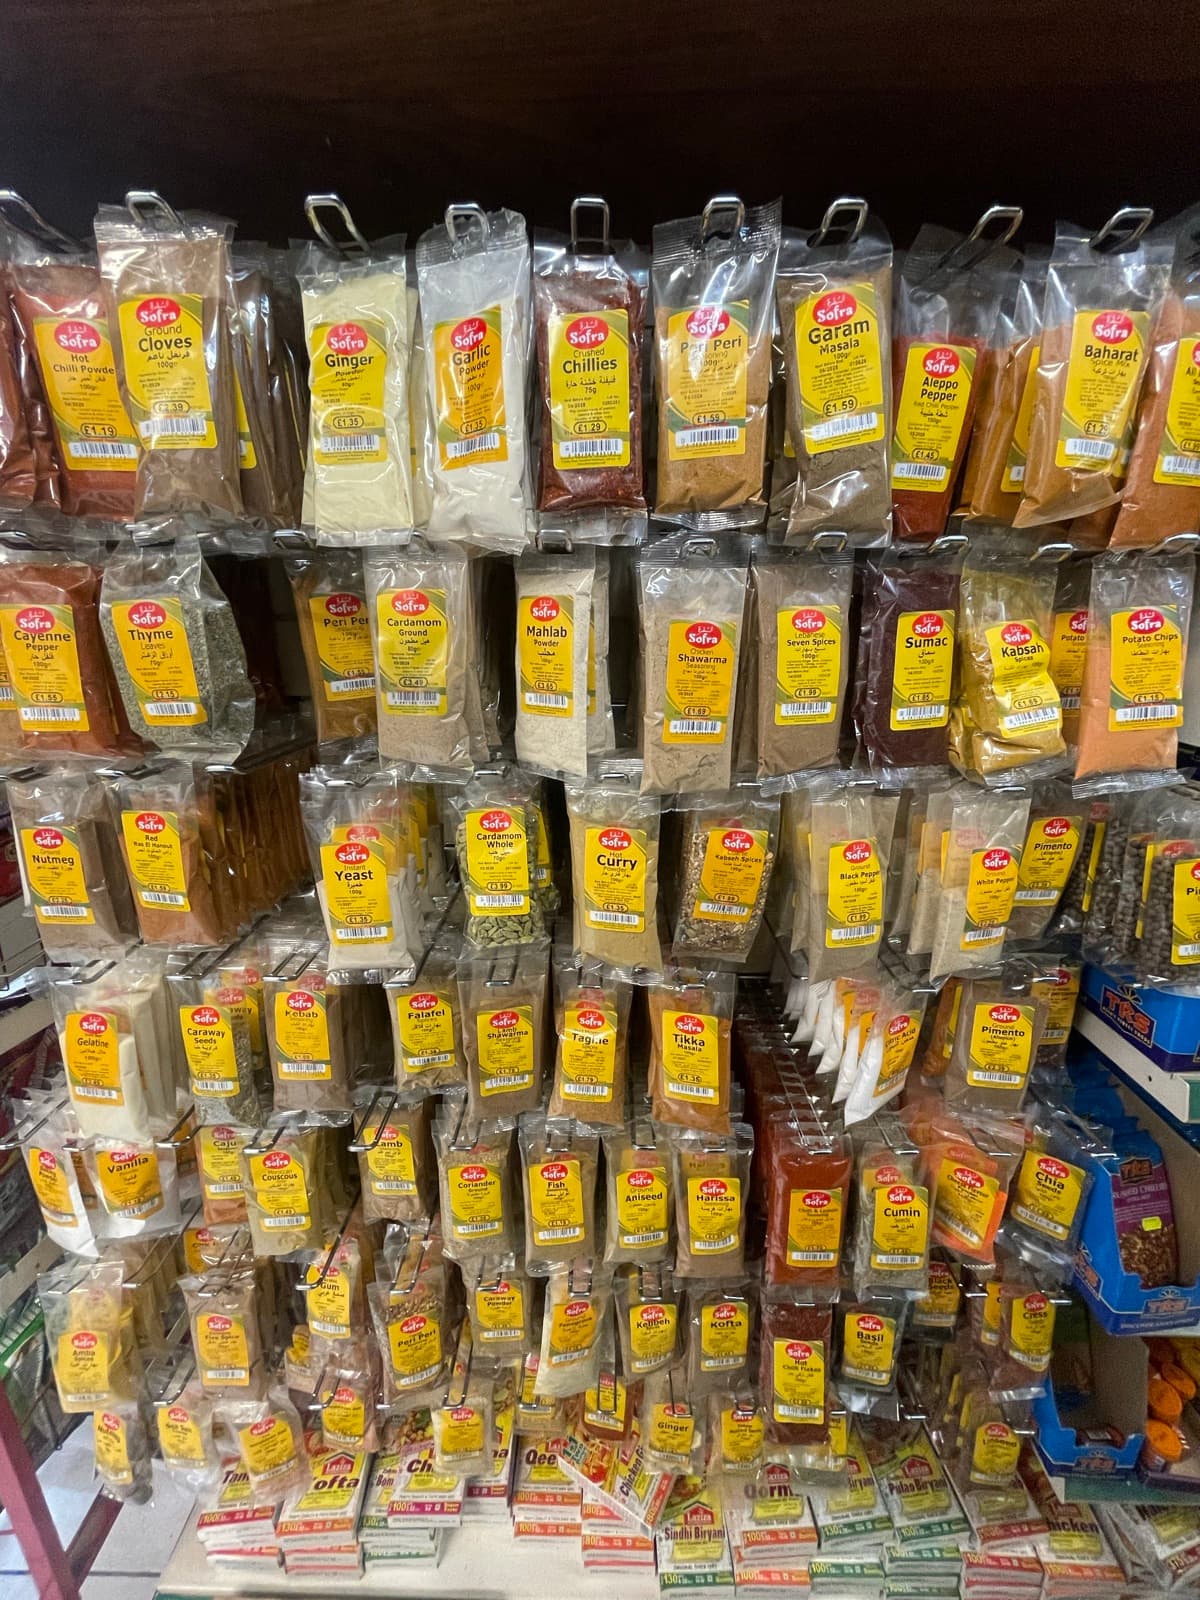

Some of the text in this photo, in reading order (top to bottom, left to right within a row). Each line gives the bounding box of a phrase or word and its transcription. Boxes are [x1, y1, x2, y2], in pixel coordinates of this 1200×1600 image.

[140, 309, 176, 326] Sofra
[817, 306, 853, 324] Sofra
[144, 325, 182, 335] Ground
[688, 319, 725, 333] Sofra
[808, 319, 870, 344] Garam
[1094, 324, 1129, 339] Sofra
[59, 332, 97, 350] Sofra
[455, 331, 483, 349] Sofra
[570, 330, 605, 344] Sofra
[139, 336, 192, 352] Cloves
[330, 337, 365, 350] Sofra
[713, 337, 742, 350] Peri
[820, 337, 859, 355] Masala
[72, 354, 88, 362] Hot
[452, 344, 490, 366] Garlic
[574, 348, 605, 359] Crushed
[1085, 344, 1138, 362] Baharat
[325, 354, 374, 369] Ginger
[563, 358, 617, 374] Chillies
[925, 359, 956, 374] Sofra
[54, 364, 115, 374] Chilli Powde
[335, 368, 365, 377] Powder
[459, 359, 489, 376] Powder
[922, 376, 959, 390] Aleppo
[921, 389, 957, 402] Pepper
[826, 400, 854, 414] £1.59
[330, 603, 358, 613] Sofra
[395, 601, 425, 612] Sofra
[532, 607, 557, 618] Sofra
[19, 618, 51, 629] Sofra
[132, 613, 163, 624] Sofra
[324, 617, 369, 628] Peri Per
[387, 618, 442, 627] Cardamom
[795, 619, 823, 629] Sofra
[915, 622, 941, 634] Sofra
[1131, 619, 1161, 630] Sofra
[14, 630, 71, 643] Cayenne
[128, 629, 173, 642] Thyme
[527, 625, 567, 638] Mahlab
[1004, 630, 1030, 644] Sofra
[534, 640, 559, 648] Powder
[688, 632, 718, 645] Sofra
[812, 638, 836, 647] Spices
[905, 637, 948, 648] Sumac
[1123, 633, 1178, 644] Potato Chips
[26, 643, 59, 651] Pepper
[141, 642, 165, 650] Leaves
[1002, 643, 1044, 658] Kabsah
[678, 654, 727, 664] Shawarma
[1014, 655, 1034, 663] Spices
[686, 662, 716, 671] Seasoning
[138, 821, 163, 831] Sofra
[482, 820, 510, 830] Sofra
[1045, 826, 1067, 835] Sofra
[36, 837, 61, 846] Sofra
[477, 833, 522, 841] Cardamom
[601, 837, 629, 847] Sofra
[486, 840, 513, 849] Whole
[724, 839, 750, 849] Sofra
[1033, 842, 1072, 850] Pimento
[32, 855, 74, 866] Nutmeg
[338, 852, 367, 862] Sofra
[846, 851, 869, 861] Sofra
[597, 854, 637, 870] Curry
[984, 858, 1009, 868] Sofra
[335, 870, 374, 881] Yeast
[860, 870, 880, 879] Pepper
[976, 878, 994, 886] White
[288, 1000, 312, 1008] Sofra
[412, 1000, 436, 1008] Sofra
[285, 1010, 318, 1019] Kebab
[408, 1010, 445, 1020] Falafel
[991, 1011, 1017, 1022] Sofra
[1105, 991, 1151, 1034] TRS
[194, 1015, 218, 1024] Sofra
[492, 1018, 516, 1027] Sofra
[579, 1017, 602, 1026] Sofra
[82, 1022, 105, 1032] Sofra
[677, 1021, 701, 1032] Sofra
[890, 1020, 909, 1033] Sofra
[981, 1026, 1025, 1037] Pimento
[187, 1028, 226, 1039] Caraway
[487, 1030, 529, 1040] Shawarma
[77, 1037, 109, 1048] Gelatine
[672, 1033, 705, 1047] Tikka
[678, 1044, 702, 1052] Masala
[213, 1140, 237, 1148] Caju
[107, 1156, 149, 1173] Vanilla
[265, 1157, 289, 1168] Sofra
[543, 1170, 566, 1178] Sofra
[1039, 1162, 1067, 1178] Sofra
[262, 1173, 298, 1181] Couscous
[630, 1177, 652, 1185] Sofra
[955, 1172, 982, 1187] Sofra
[1035, 1172, 1065, 1189] Chia
[458, 1180, 496, 1189] Coriander
[702, 1186, 725, 1194] Sofra
[625, 1192, 663, 1202] Aniseed
[805, 1197, 828, 1206] Sofra
[884, 1207, 920, 1217] Cumin
[320, 1283, 340, 1291] Gum
[1023, 1312, 1048, 1320] Cress
[402, 1322, 424, 1332] Sofra
[710, 1320, 742, 1329] Kofta
[858, 1320, 882, 1330] Sofra
[397, 1329, 436, 1347] Peri Peri
[856, 1331, 884, 1342] Basil
[786, 1348, 810, 1358] Sofra
[657, 1421, 689, 1433] Ginger
[525, 1448, 556, 1465] Qee
[620, 1457, 642, 1497] Chicken
[313, 1476, 360, 1490] ofta
[889, 1477, 948, 1494] Pulao Biryani
[664, 1526, 725, 1541] Sindhi Biryani
